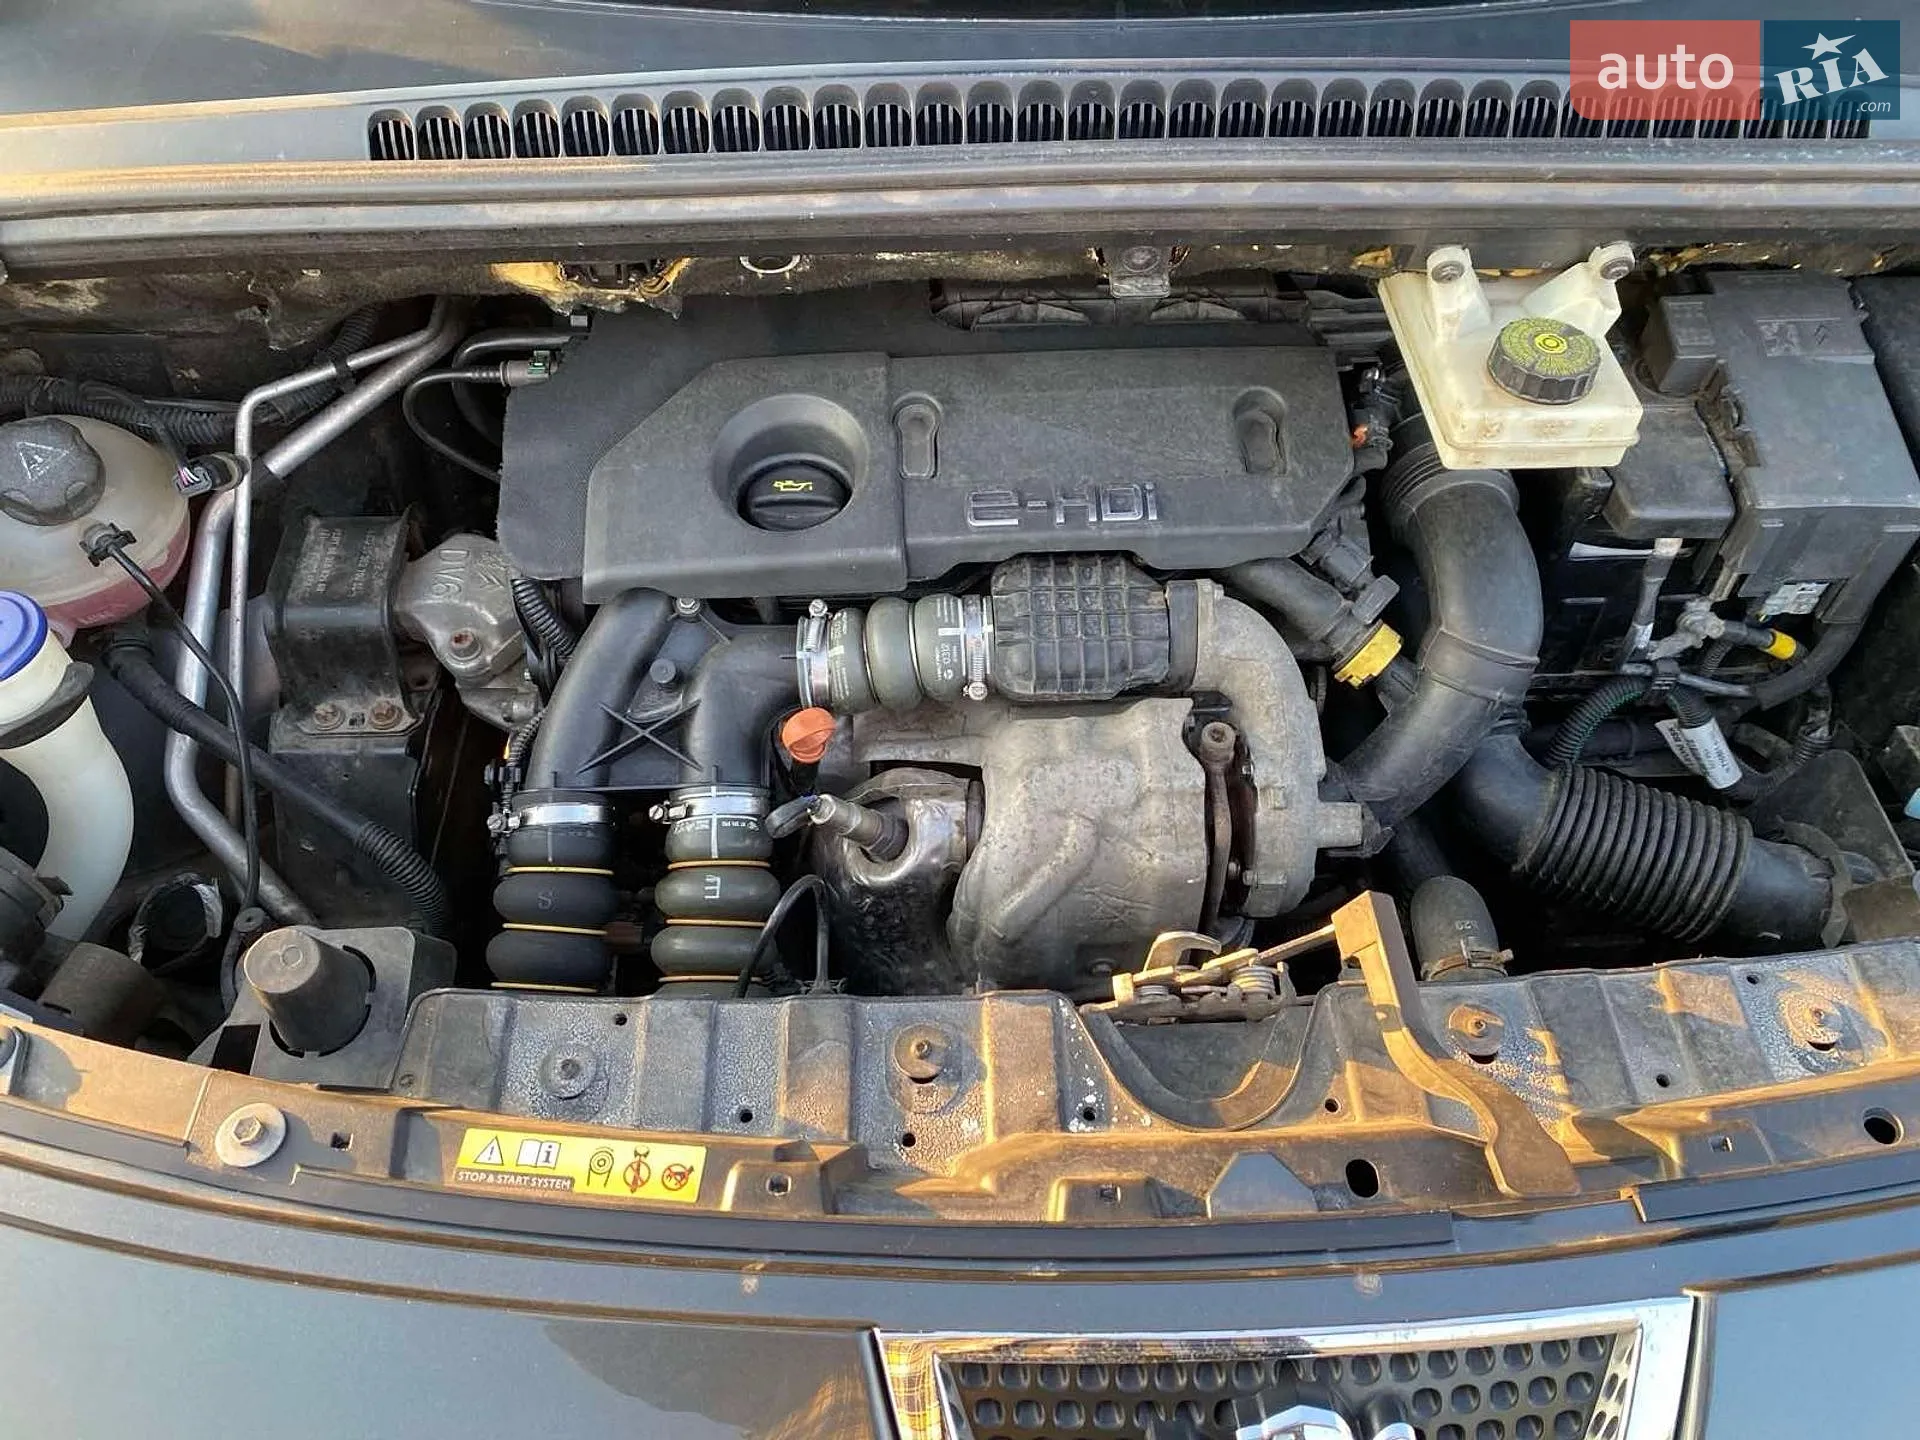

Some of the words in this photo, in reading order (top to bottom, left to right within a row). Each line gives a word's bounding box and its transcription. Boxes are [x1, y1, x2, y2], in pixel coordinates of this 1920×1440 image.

[458, 1171, 486, 1182] STOP
[486, 1174, 495, 1182] &
[497, 1175, 530, 1186] START
[530, 1178, 571, 1190] SYSTEM
